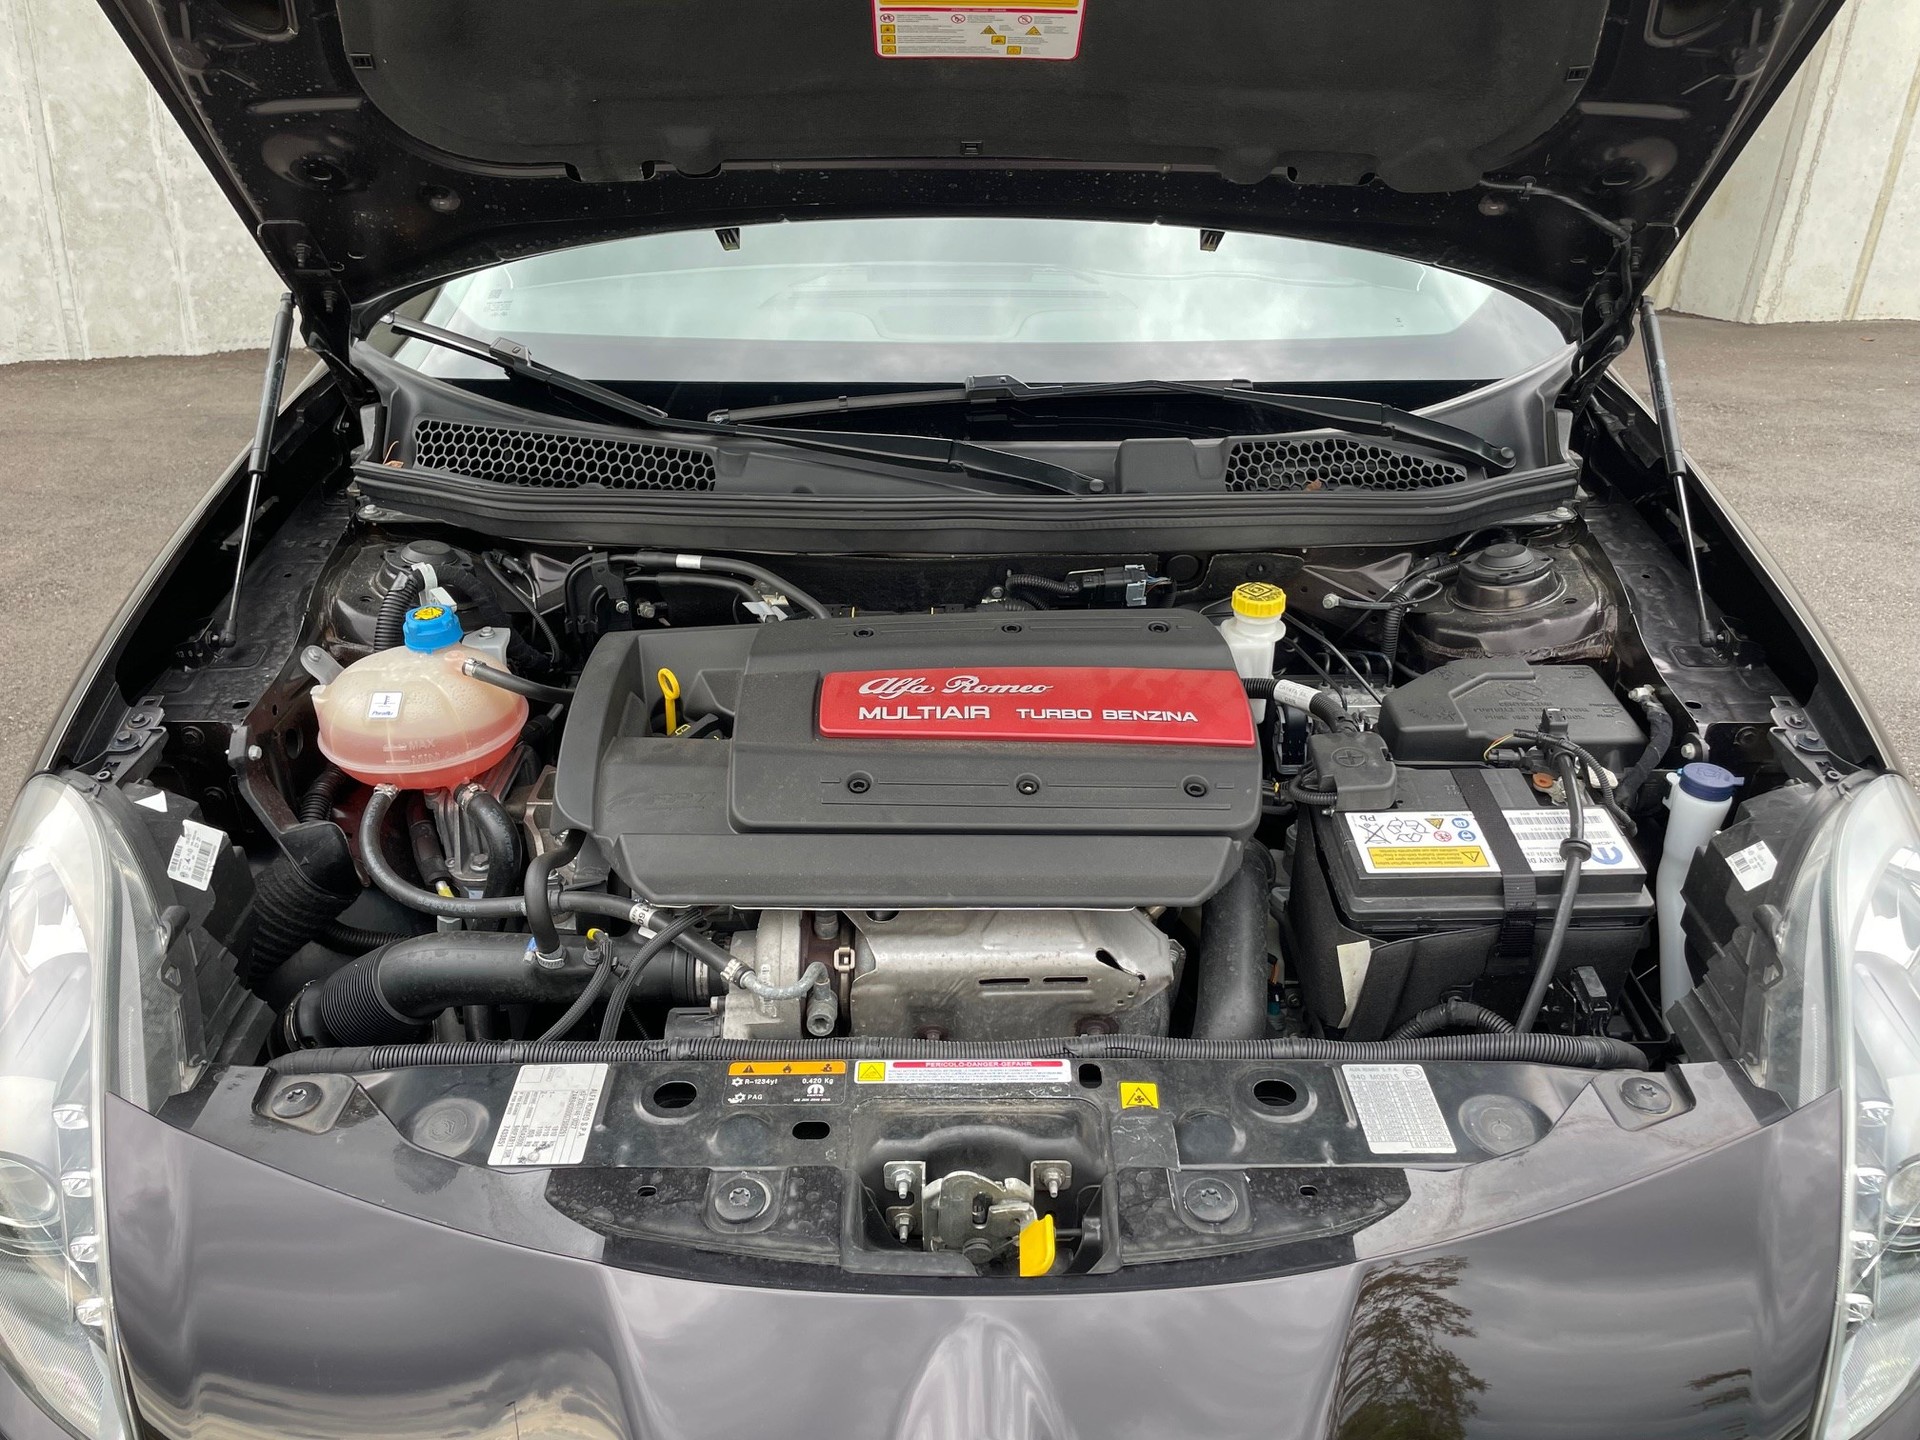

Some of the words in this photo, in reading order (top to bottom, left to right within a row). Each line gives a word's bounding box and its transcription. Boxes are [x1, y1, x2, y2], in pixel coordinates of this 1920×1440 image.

[858, 677, 935, 700] Alfa
[941, 675, 1054, 694] Romeo
[858, 706, 990, 720] MULTIAIR
[1016, 708, 1092, 720] TURBO
[1102, 710, 1198, 722] BENZINA
[587, 1088, 598, 1101] ALFA
[581, 1102, 594, 1120] ROMEO
